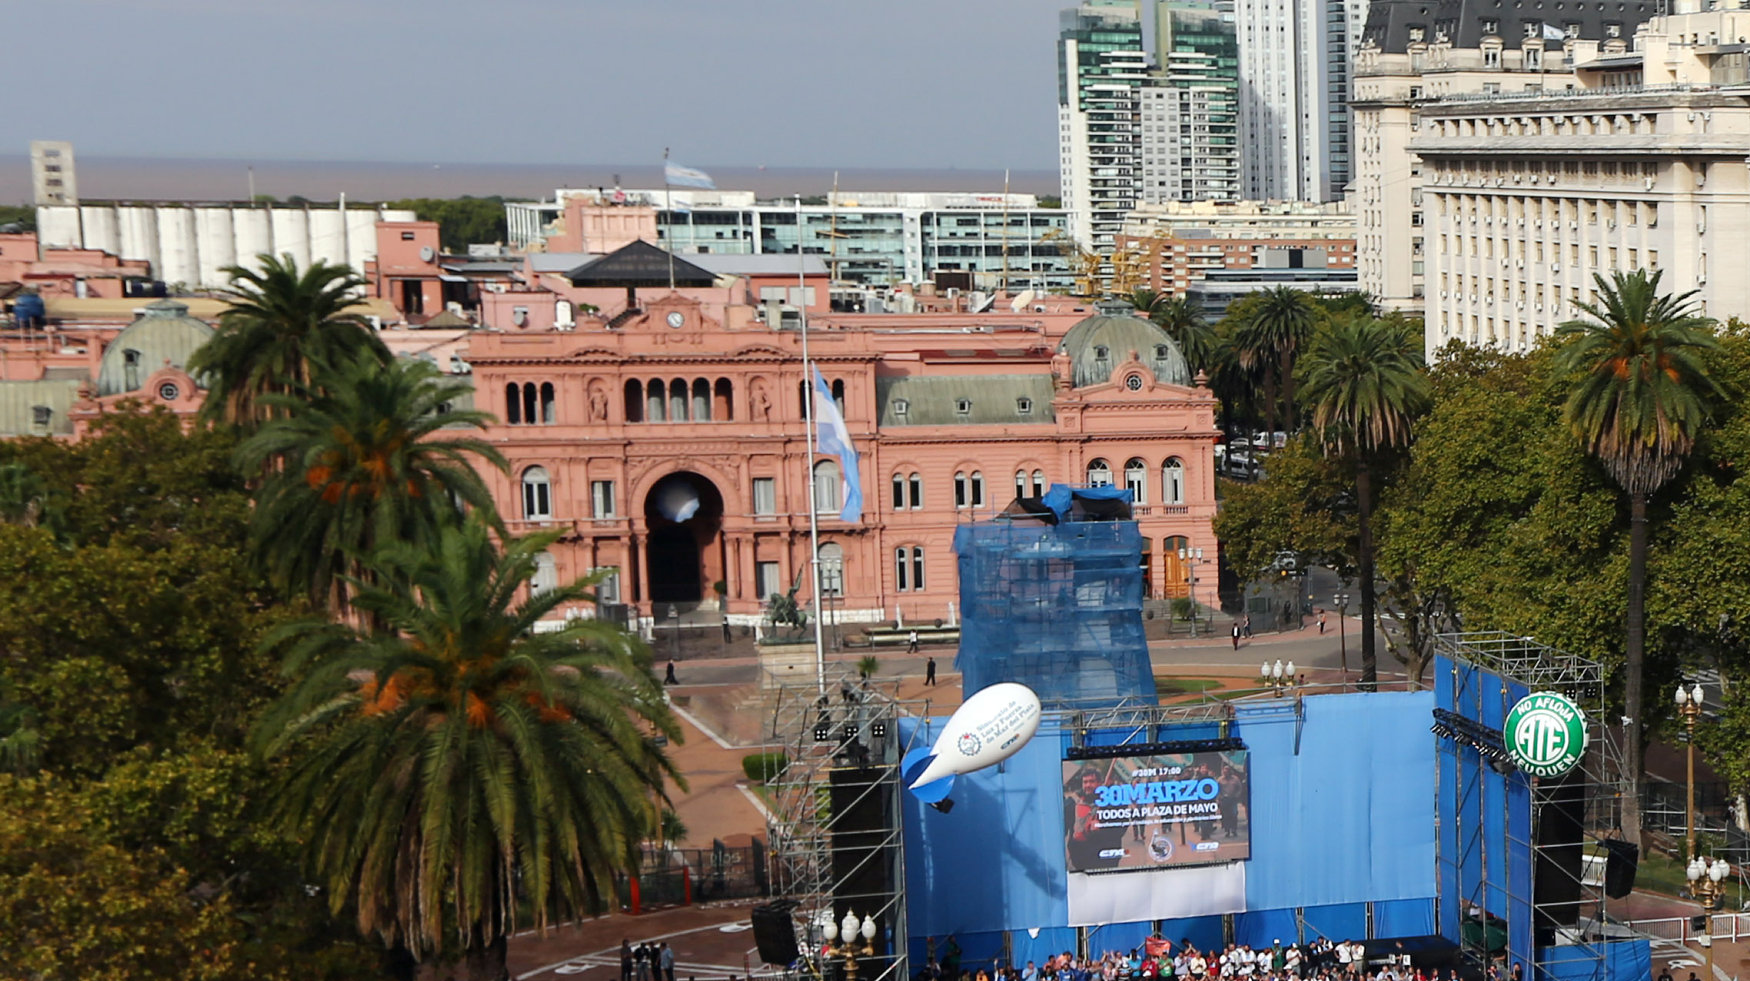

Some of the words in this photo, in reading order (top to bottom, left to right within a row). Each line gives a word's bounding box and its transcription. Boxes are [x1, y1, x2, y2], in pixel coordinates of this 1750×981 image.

[1516, 701, 1532, 716] NO
[1535, 697, 1574, 722] AFLOJA
[1519, 713, 1563, 762] ATE
[1509, 749, 1576, 777] NEUQUEN
[1097, 807, 1132, 820] TODOS
[1132, 808, 1140, 818] A
[1141, 805, 1173, 817] PLAZA
[1173, 804, 1187, 815] DE
[1188, 802, 1219, 814] MAYO
